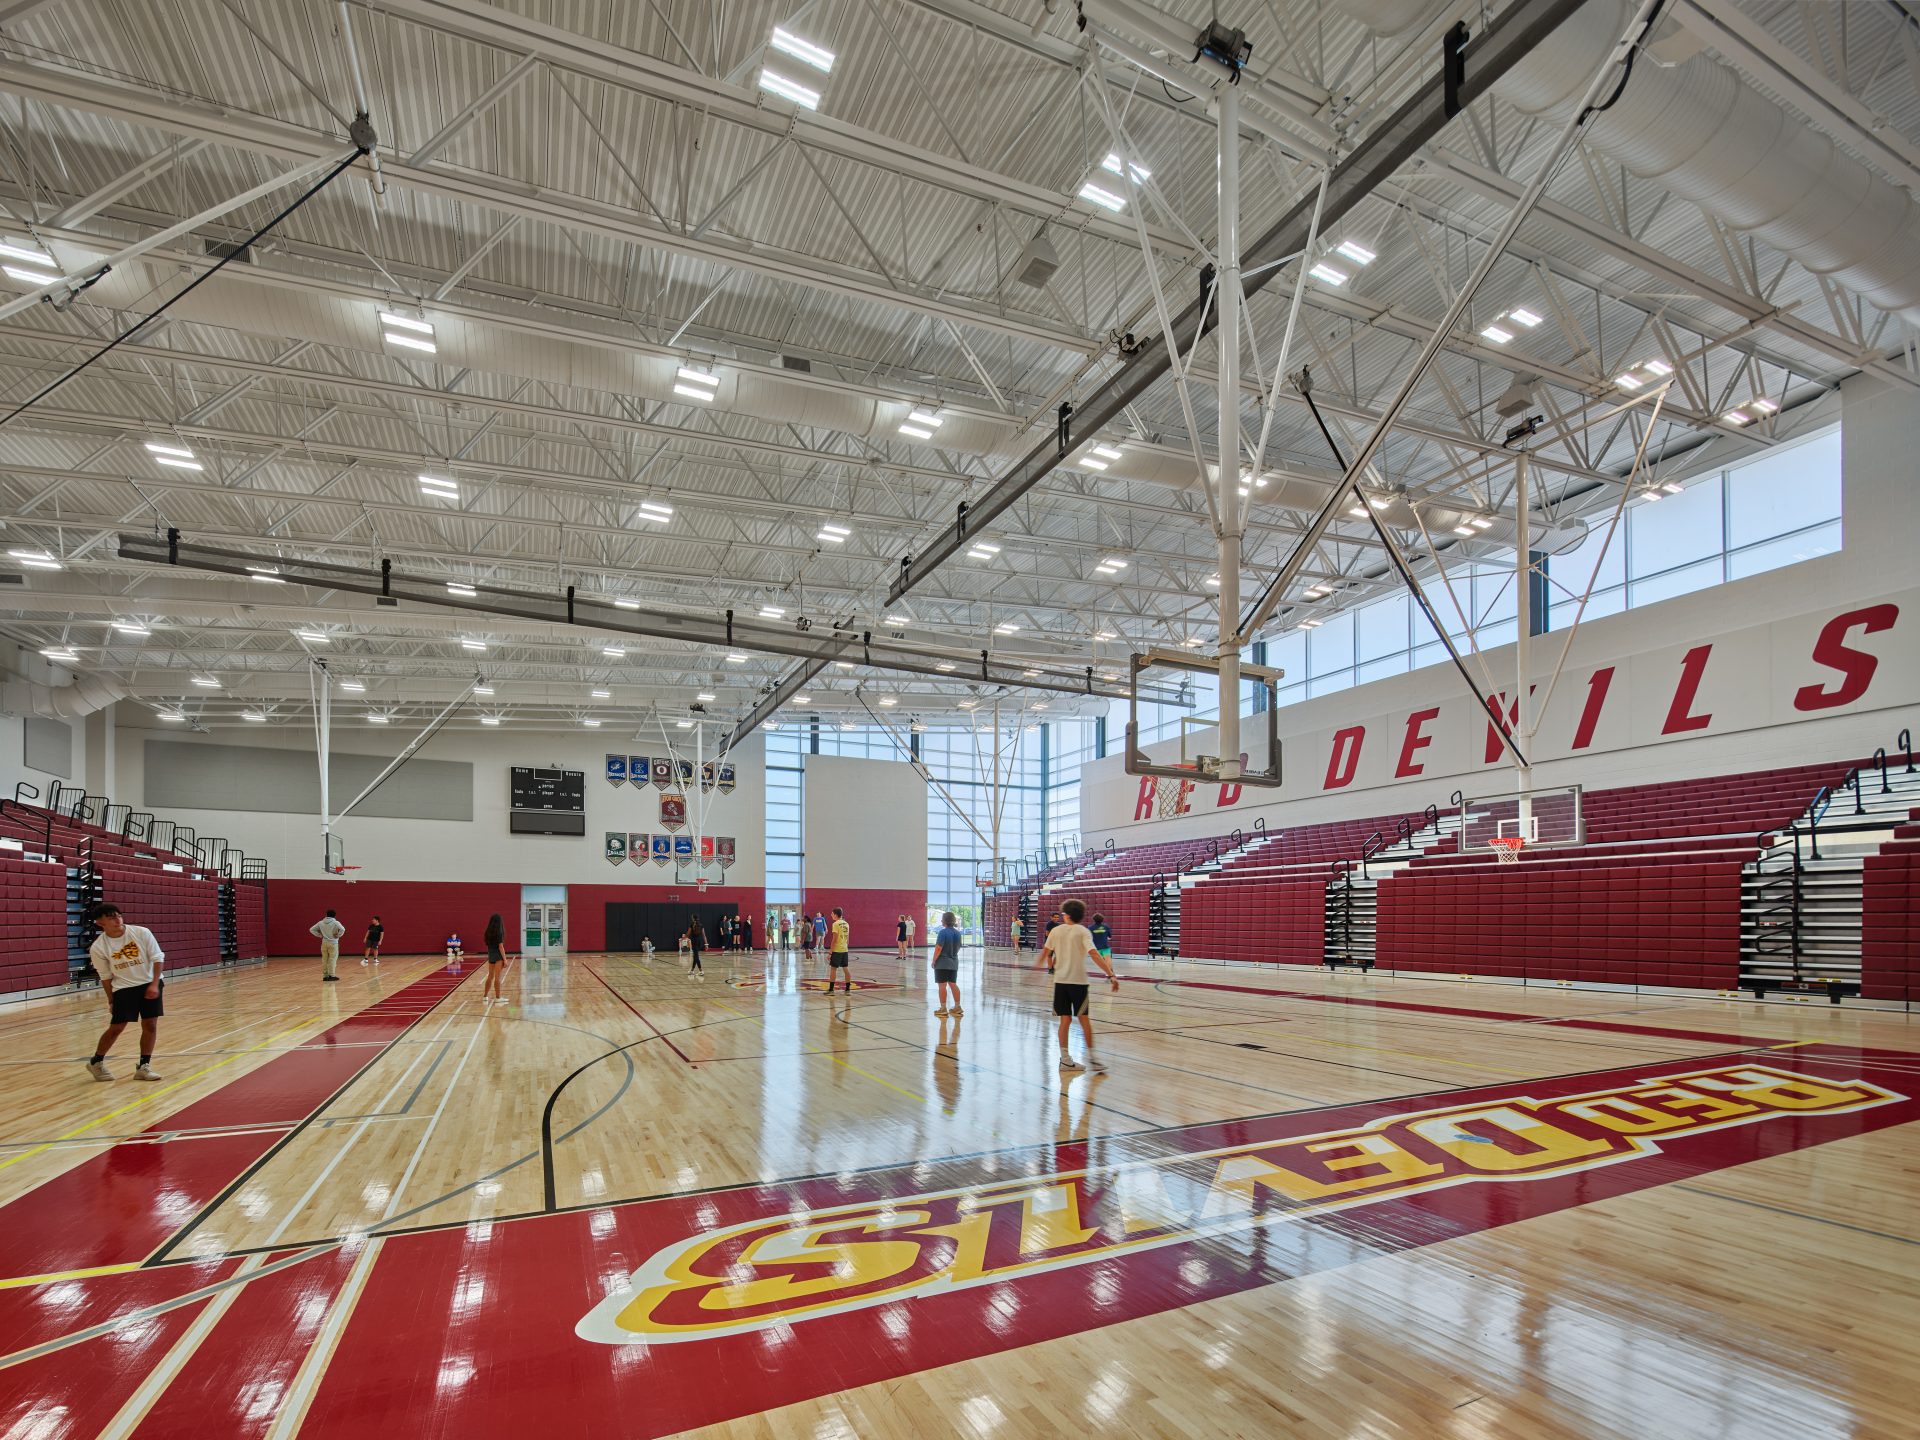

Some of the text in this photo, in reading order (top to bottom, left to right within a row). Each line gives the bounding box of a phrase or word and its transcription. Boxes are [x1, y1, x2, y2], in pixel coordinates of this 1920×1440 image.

[1322, 603, 1900, 791] DEVILS
[114, 959, 145, 971] FOOTBALL
[592, 1064, 1906, 1340] RED DEVILS
